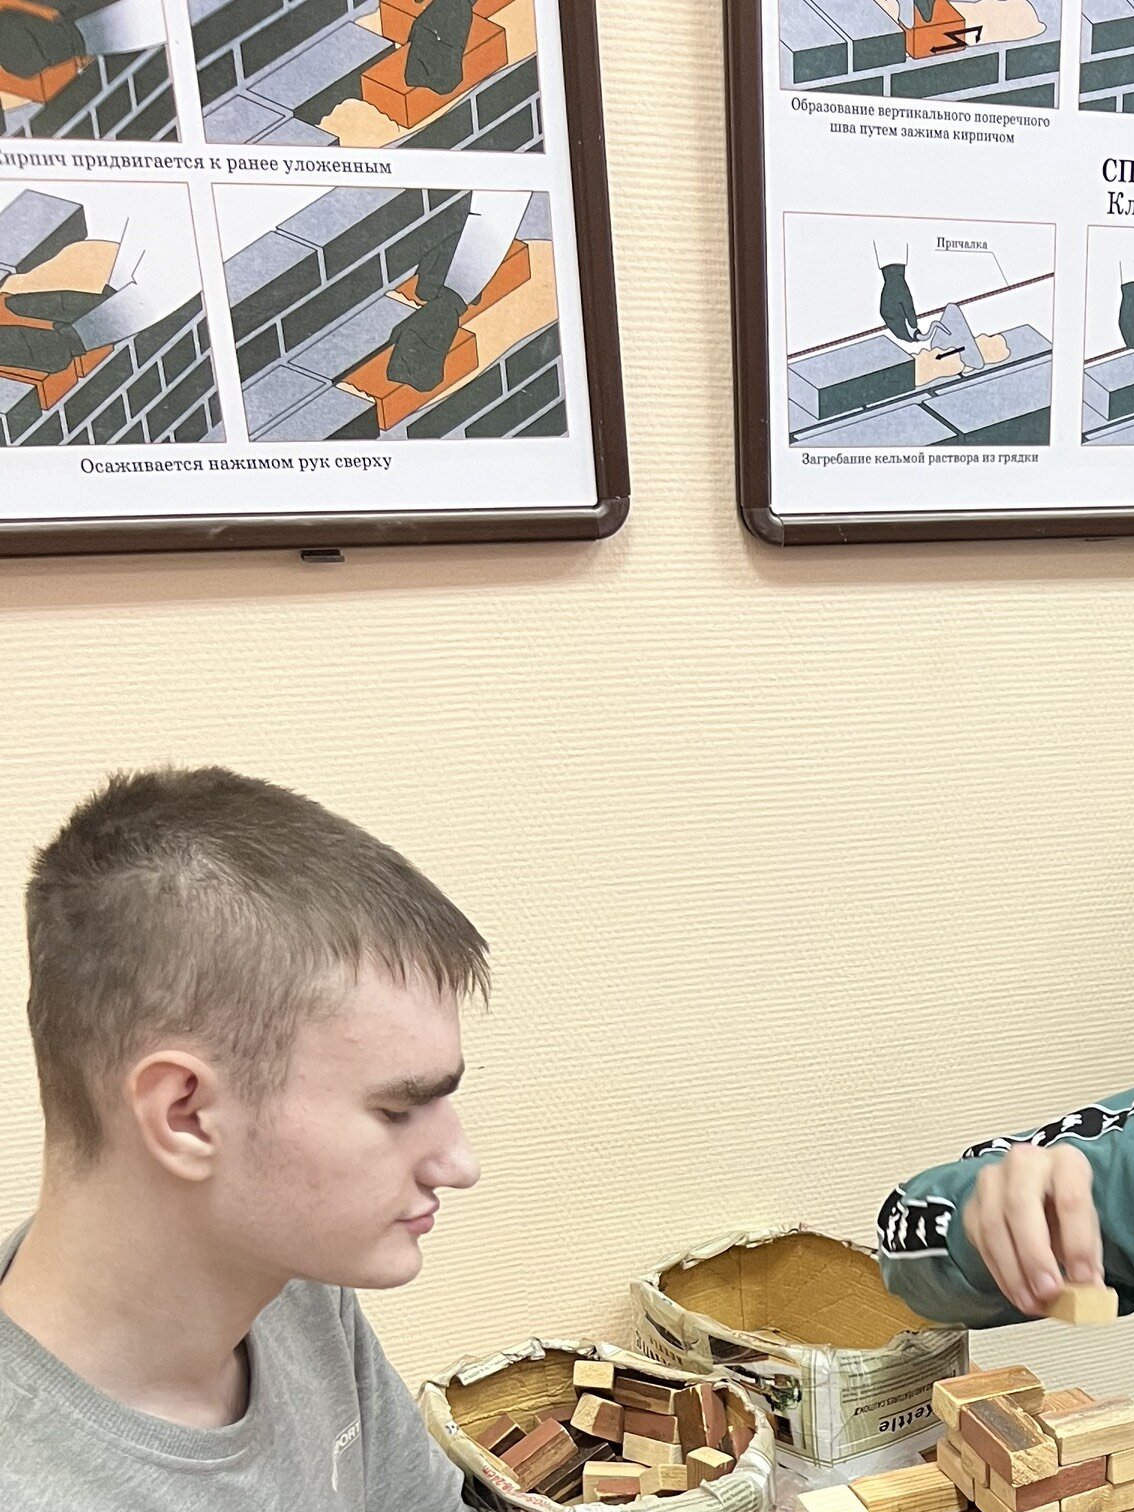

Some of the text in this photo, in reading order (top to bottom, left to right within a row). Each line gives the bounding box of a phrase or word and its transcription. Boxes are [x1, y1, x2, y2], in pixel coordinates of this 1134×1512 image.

[791, 97, 1050, 128] Образование вертикального поперечного
[830, 121, 1015, 145] шва путем зажима кирпичом
[0, 152, 392, 175] ирпич придвигается к ранее уложенным
[936, 236, 988, 250] Причалка
[80, 455, 393, 474] Осаживается нажимом рук сверху
[802, 452, 1039, 467] Загребание кельмой раствора из грядки
